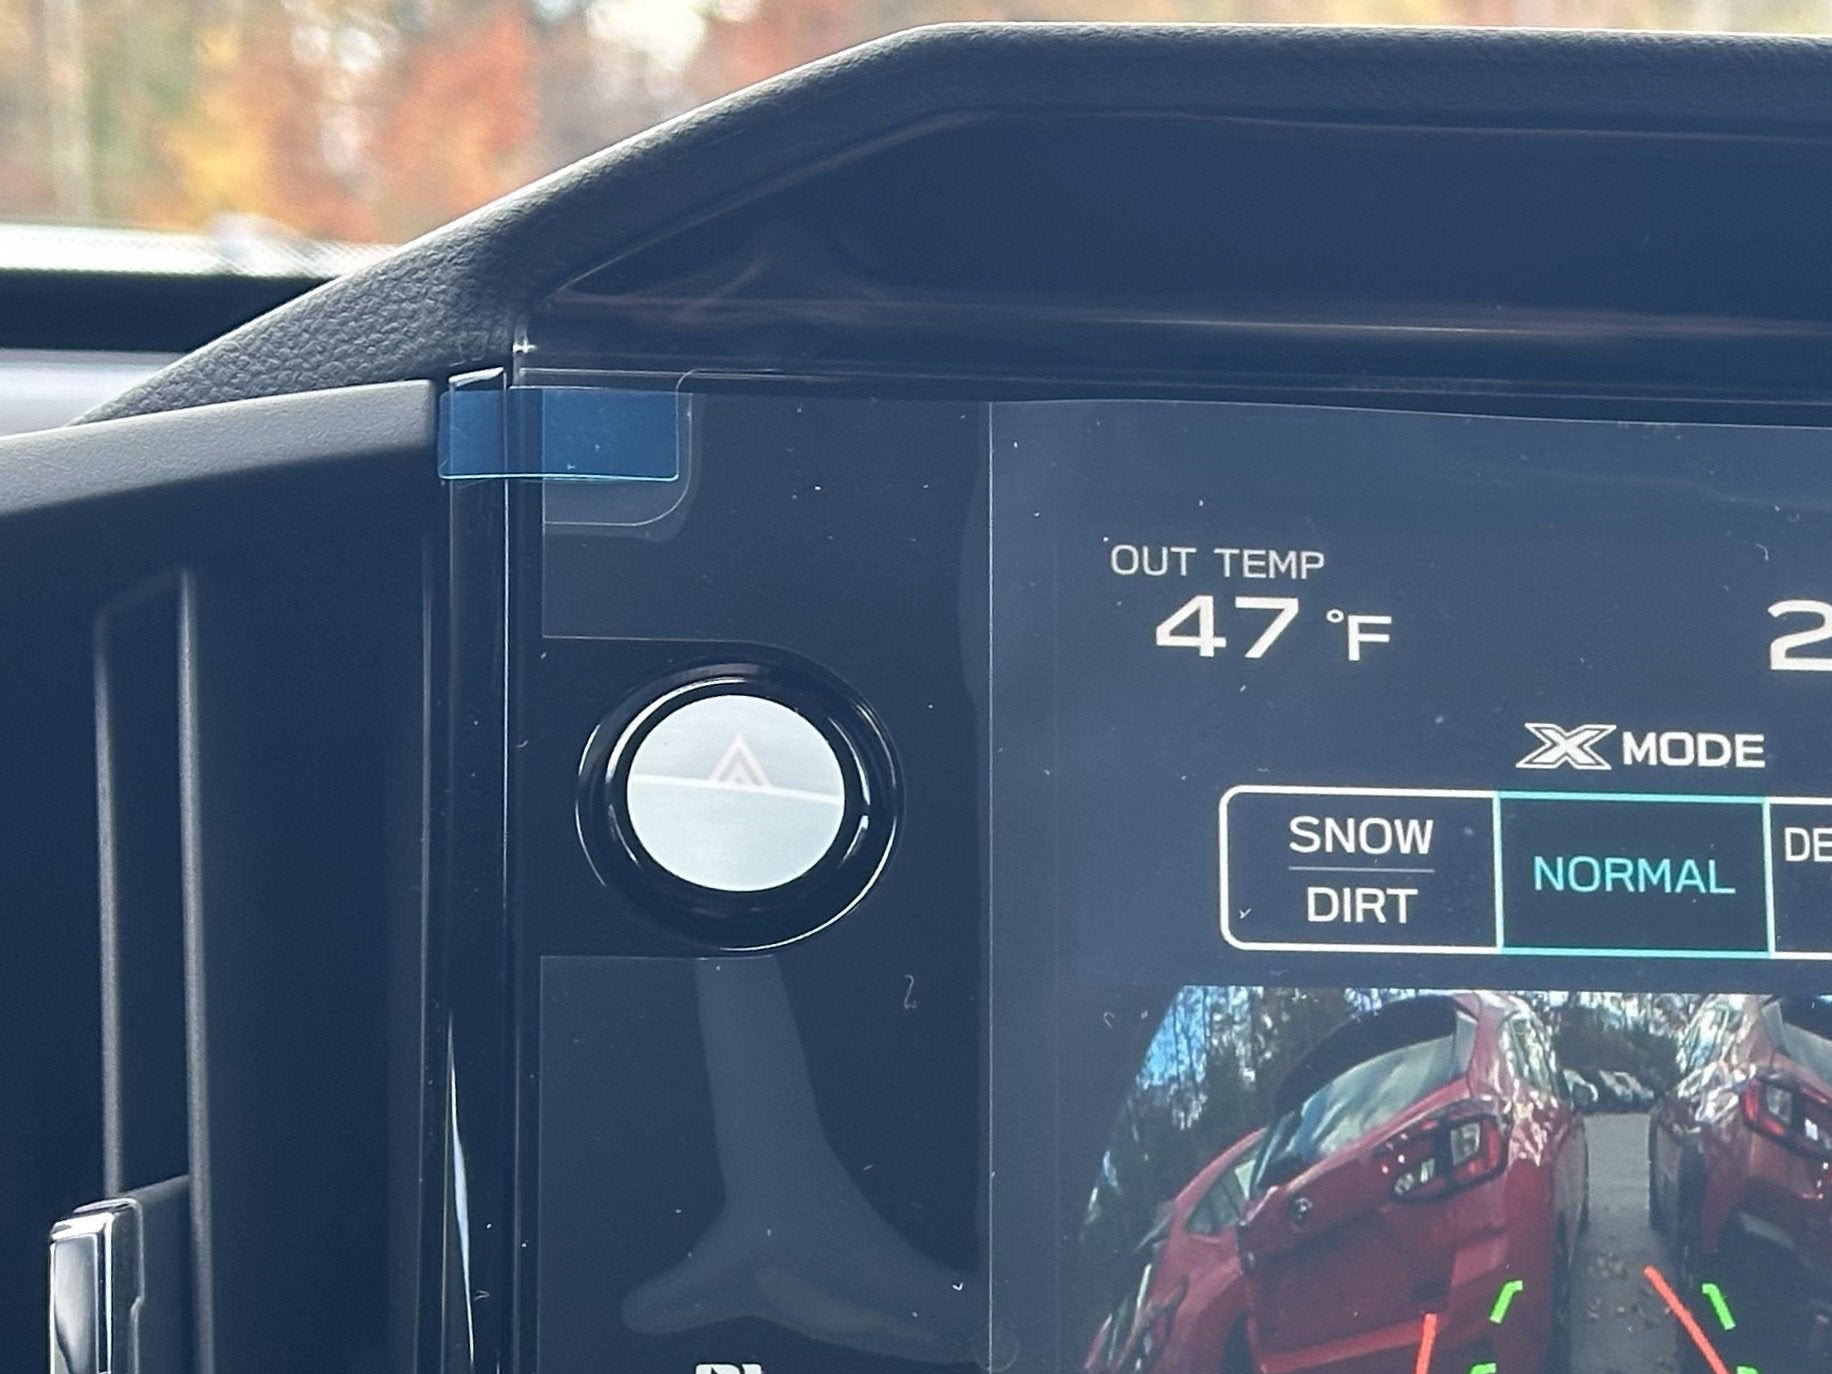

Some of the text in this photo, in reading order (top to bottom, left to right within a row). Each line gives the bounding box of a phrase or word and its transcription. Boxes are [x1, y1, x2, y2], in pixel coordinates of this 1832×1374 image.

[1110, 544, 1325, 580] OUT TEMP
[1154, 594, 1300, 661] 47
[1622, 731, 1767, 770] MODE
[1288, 816, 1435, 857] SNOW
[1532, 856, 1736, 896] NORMAL
[1306, 886, 1419, 926] DIRT
